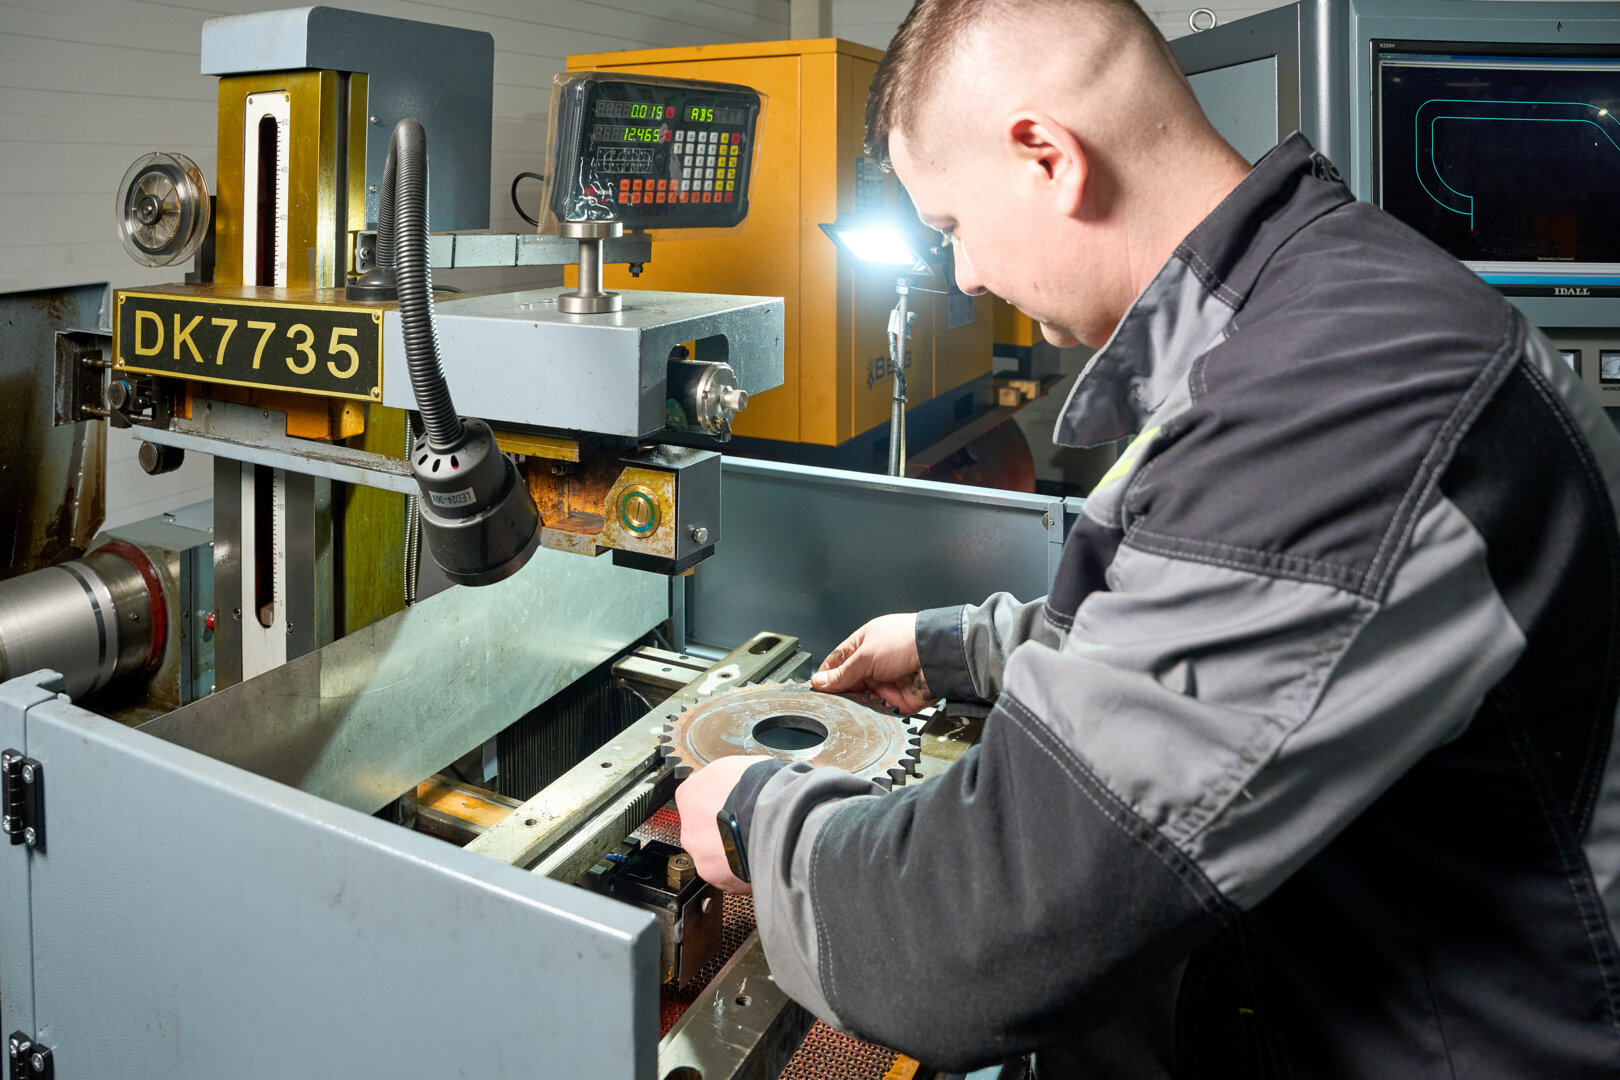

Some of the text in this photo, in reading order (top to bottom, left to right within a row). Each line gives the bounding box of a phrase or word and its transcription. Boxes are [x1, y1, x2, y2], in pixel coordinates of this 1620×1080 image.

[630, 104, 663, 119] 0.015
[690, 108, 714, 122] ABS
[623, 127, 660, 142] 12.465
[1553, 287, 1590, 296] IDALL
[135, 309, 360, 379] DK7735
[875, 351, 912, 380] BEG
